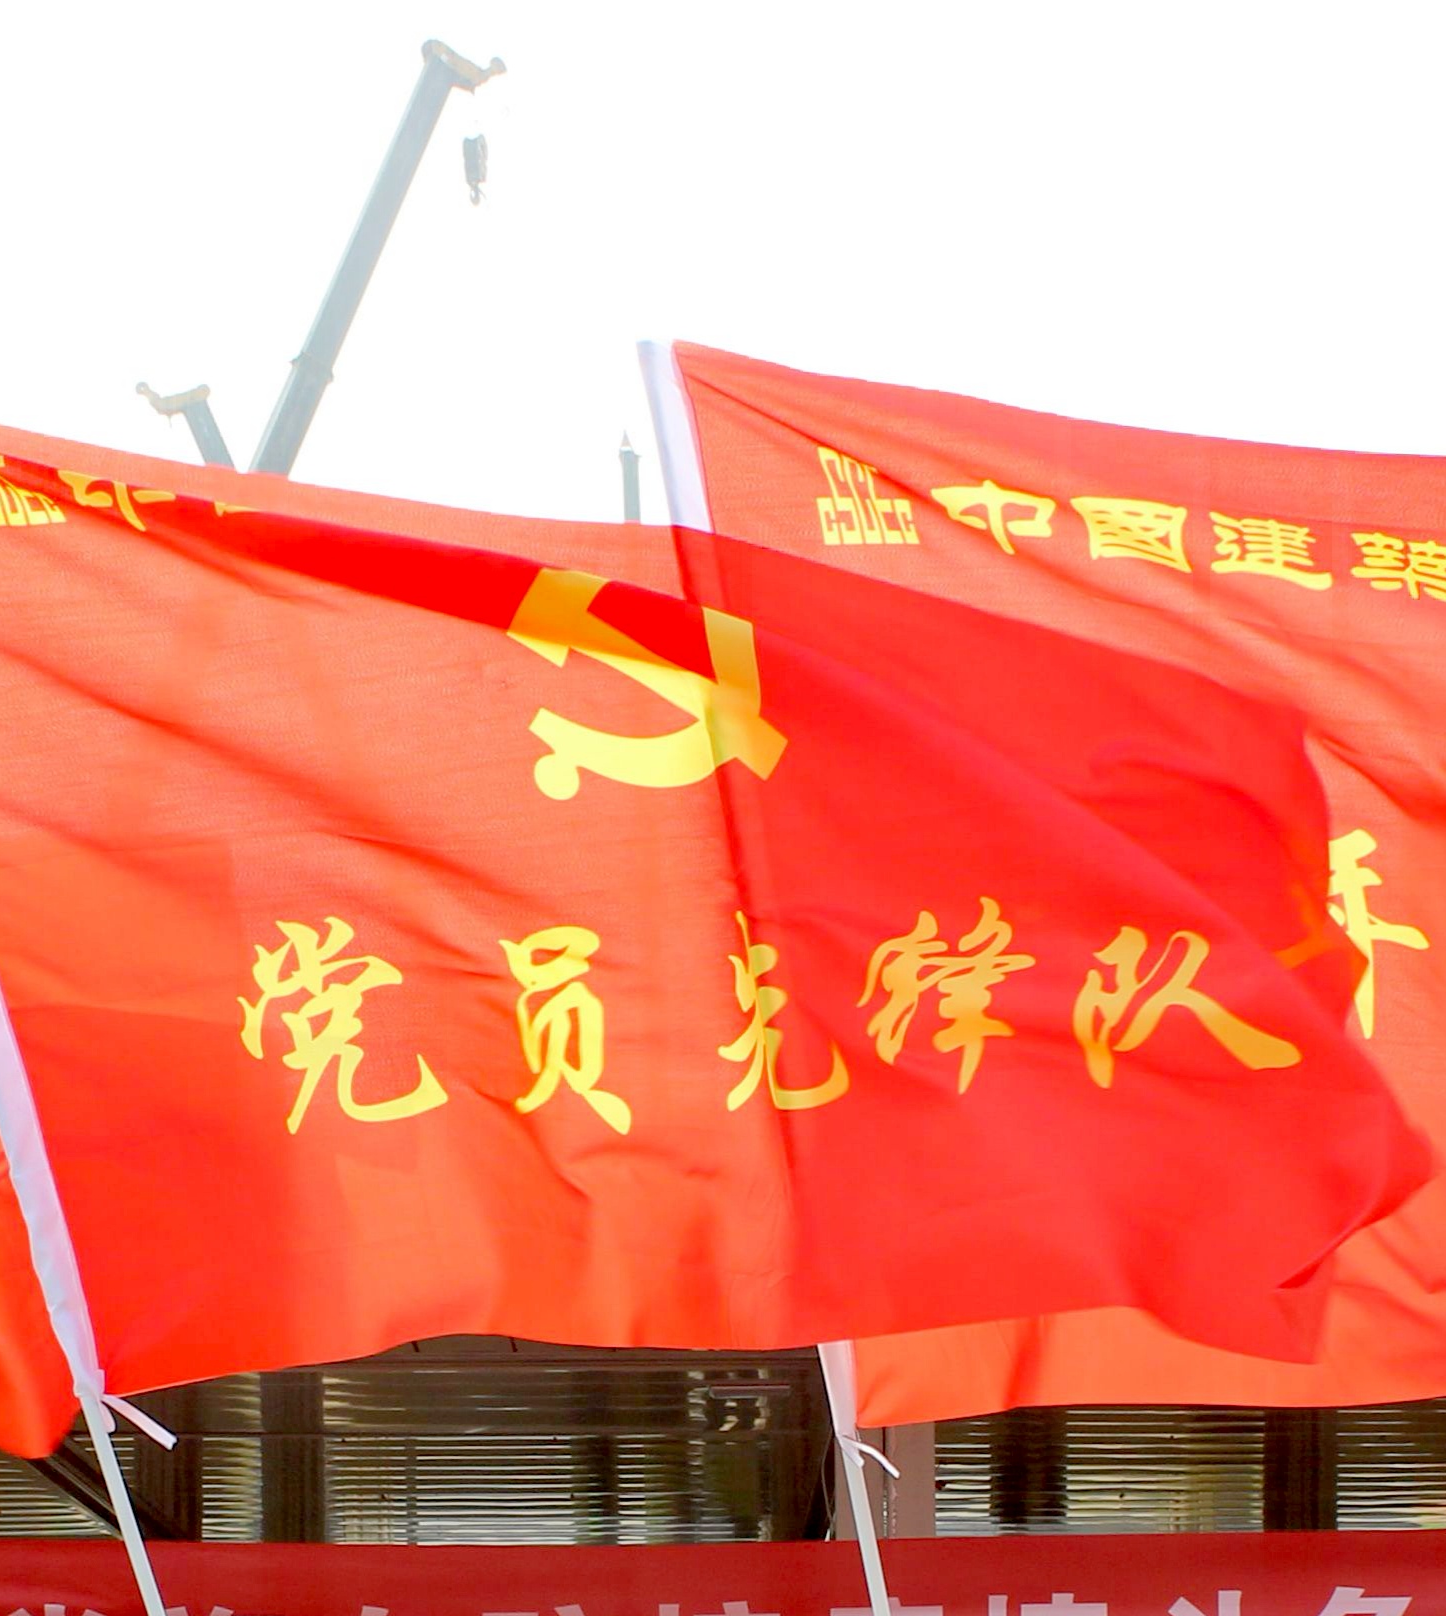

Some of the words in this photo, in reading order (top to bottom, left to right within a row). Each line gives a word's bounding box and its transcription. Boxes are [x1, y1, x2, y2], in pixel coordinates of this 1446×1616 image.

[238, 896, 1301, 1134] 党员先锋队
